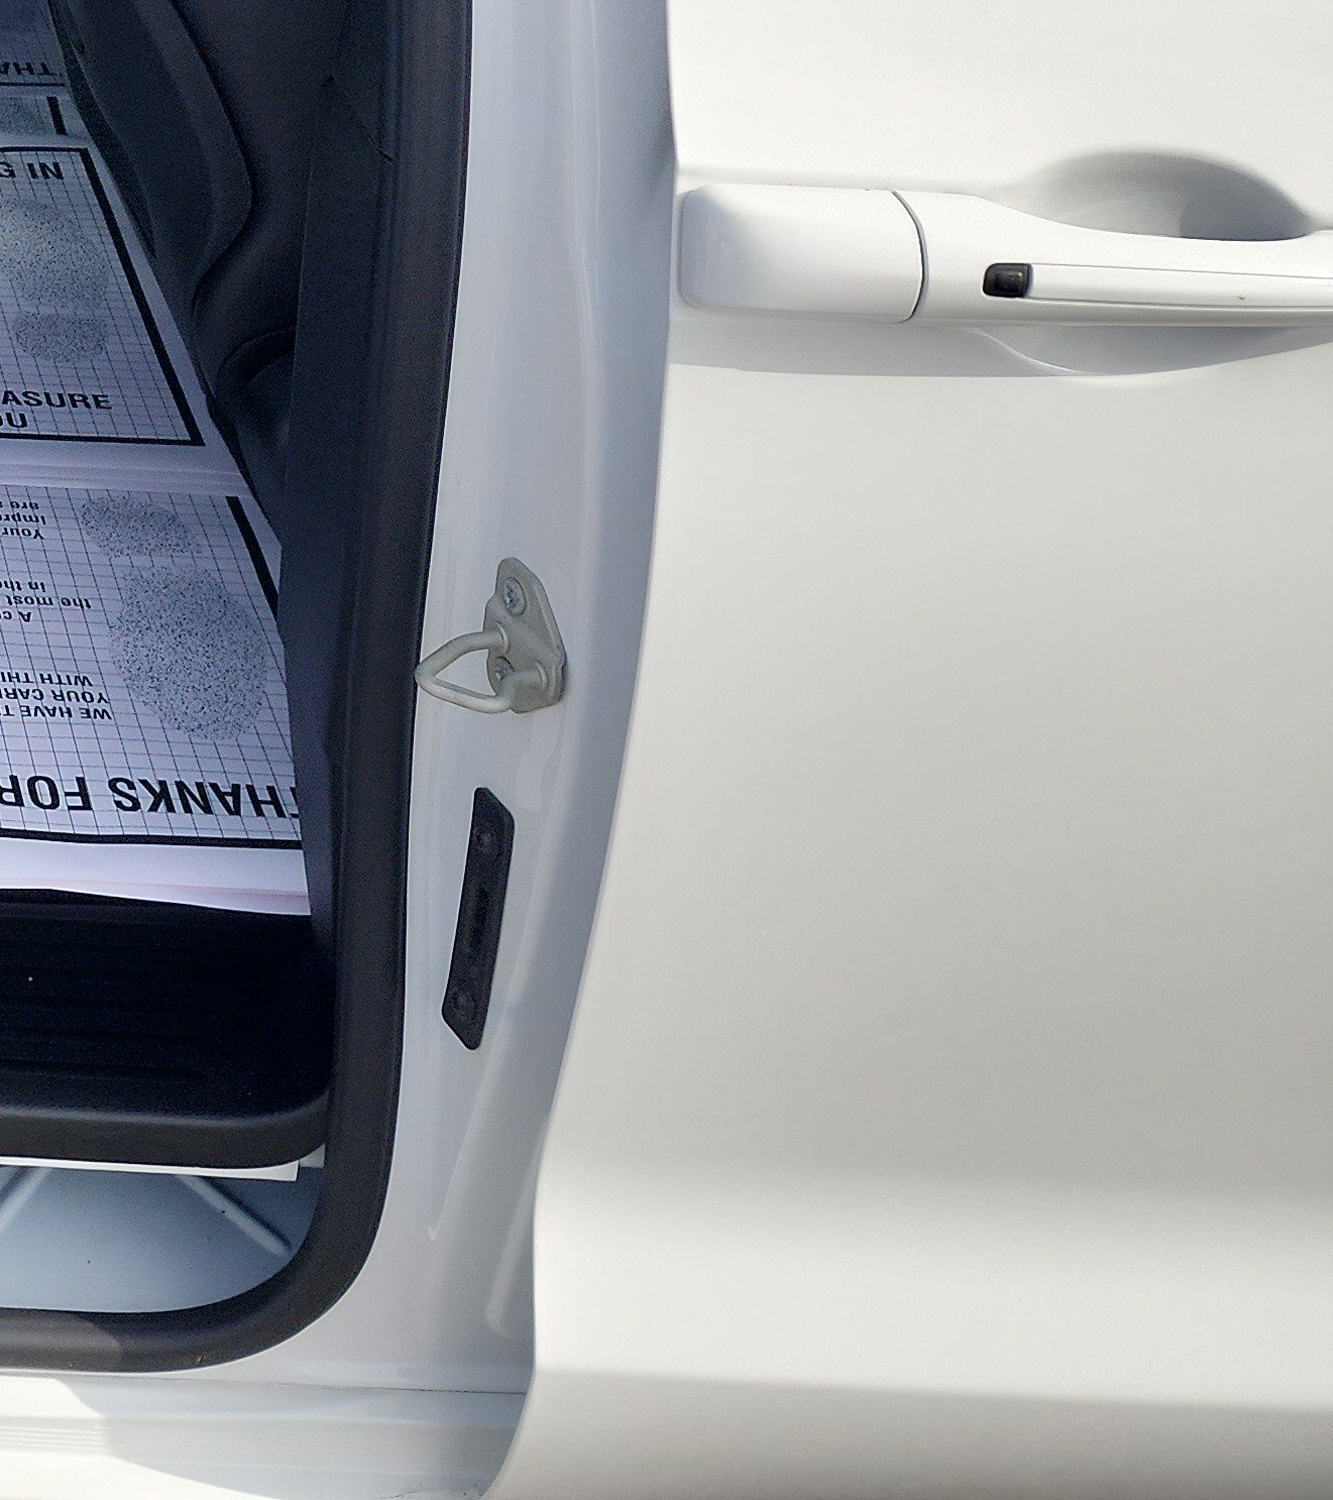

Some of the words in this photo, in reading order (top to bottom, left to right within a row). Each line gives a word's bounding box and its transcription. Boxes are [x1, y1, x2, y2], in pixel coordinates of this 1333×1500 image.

[28, 161, 64, 180] IN
[11, 501, 40, 510] are
[1, 527, 45, 540] Your
[28, 582, 46, 592] in
[6, 594, 54, 607] most
[61, 597, 92, 609] the
[18, 611, 32, 622] A
[40, 673, 94, 687] WITH
[51, 689, 110, 704] YOUR
[20, 705, 72, 719] HAVE
[79, 707, 113, 720] WE
